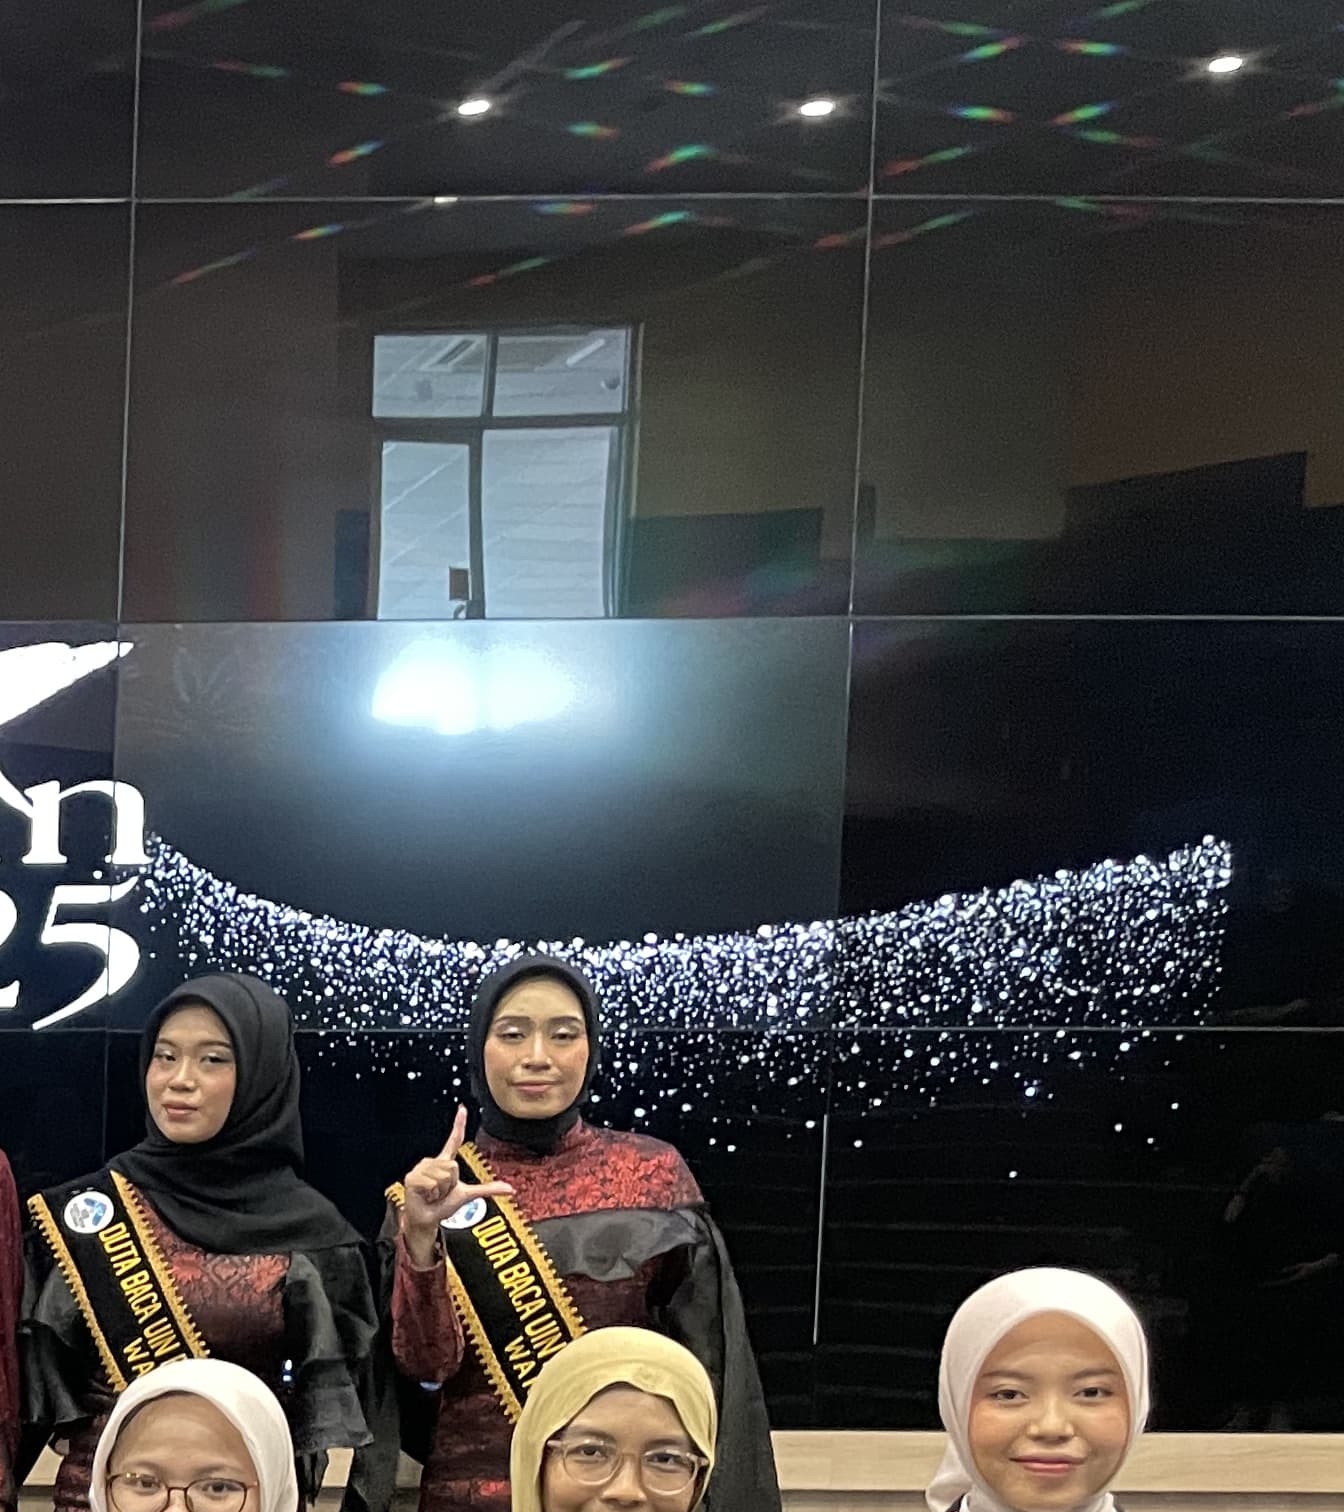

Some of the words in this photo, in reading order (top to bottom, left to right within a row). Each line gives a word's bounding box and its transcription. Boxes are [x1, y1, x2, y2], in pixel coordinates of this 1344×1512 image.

[98, 1222, 143, 1277] DUTA
[119, 1270, 163, 1324] BACA
[471, 1215, 520, 1269] DUTA
[498, 1261, 547, 1321] BACA
[524, 1313, 567, 1359] UIN
[143, 1316, 182, 1358] UIN
